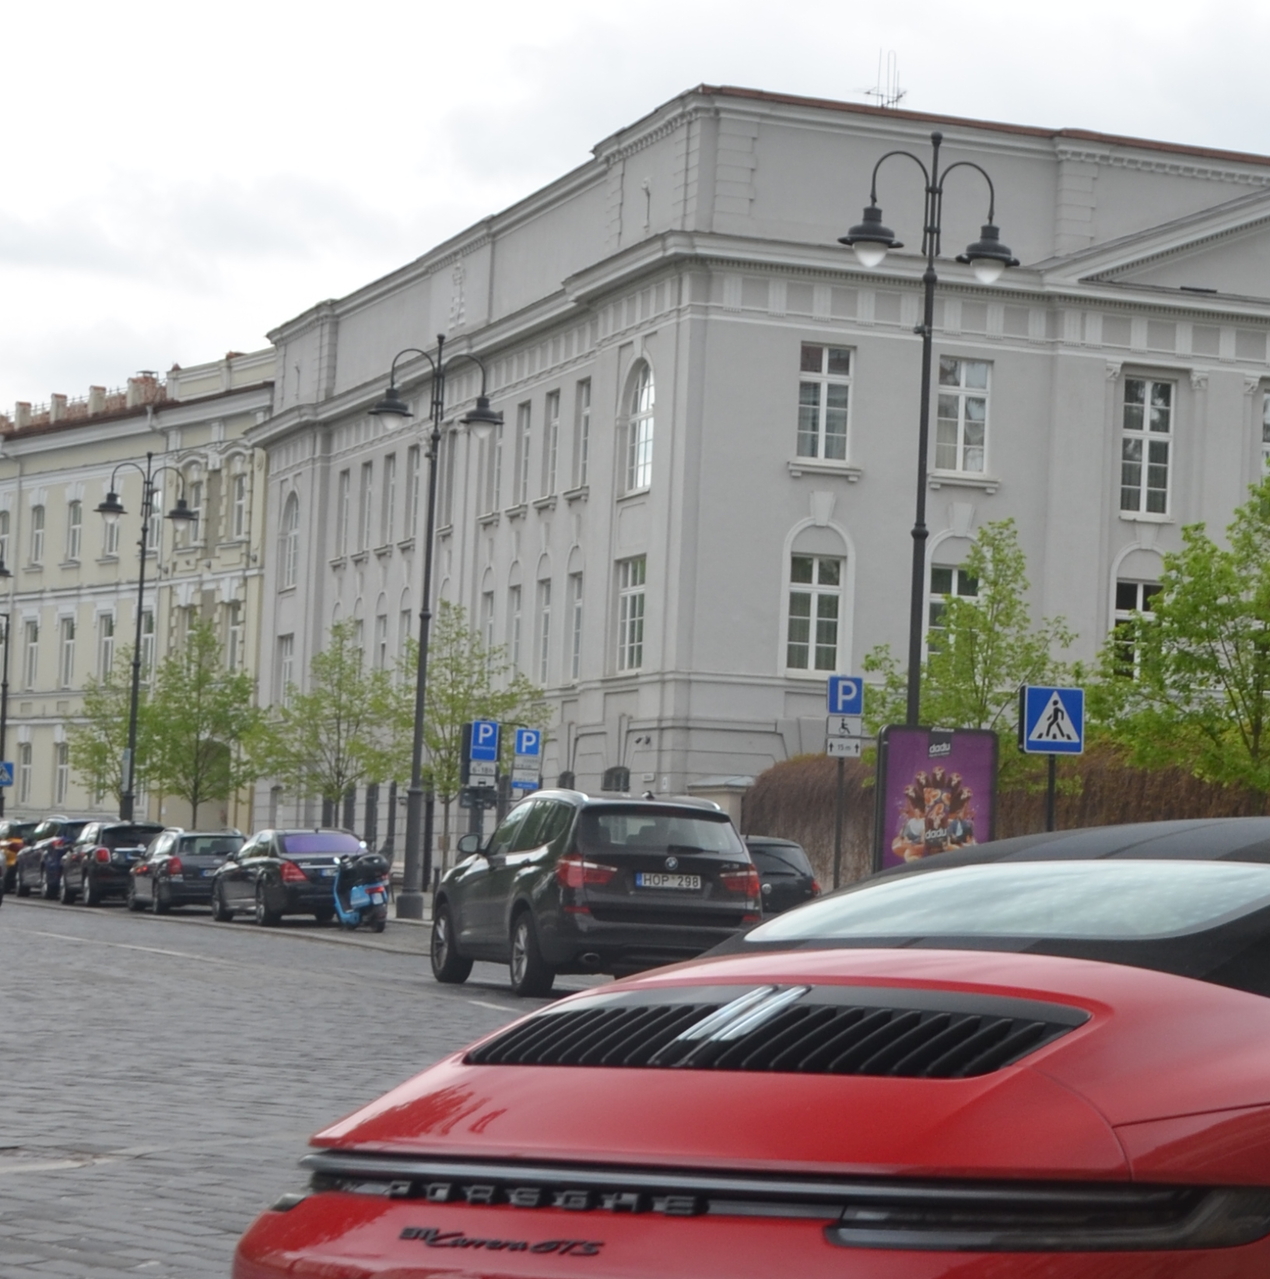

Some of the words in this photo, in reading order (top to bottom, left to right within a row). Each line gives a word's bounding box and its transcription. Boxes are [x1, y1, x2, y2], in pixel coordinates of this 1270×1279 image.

[837, 680, 857, 711] P
[479, 723, 494, 744] P
[521, 731, 536, 753] P
[929, 742, 951, 754] dadu
[924, 827, 947, 839] dadu
[643, 874, 669, 886] HOP
[677, 875, 699, 887] 298
[388, 1179, 697, 1216] PORSCHE
[425, 1232, 527, 1248] Carrera
[529, 1239, 605, 1256] GTS
